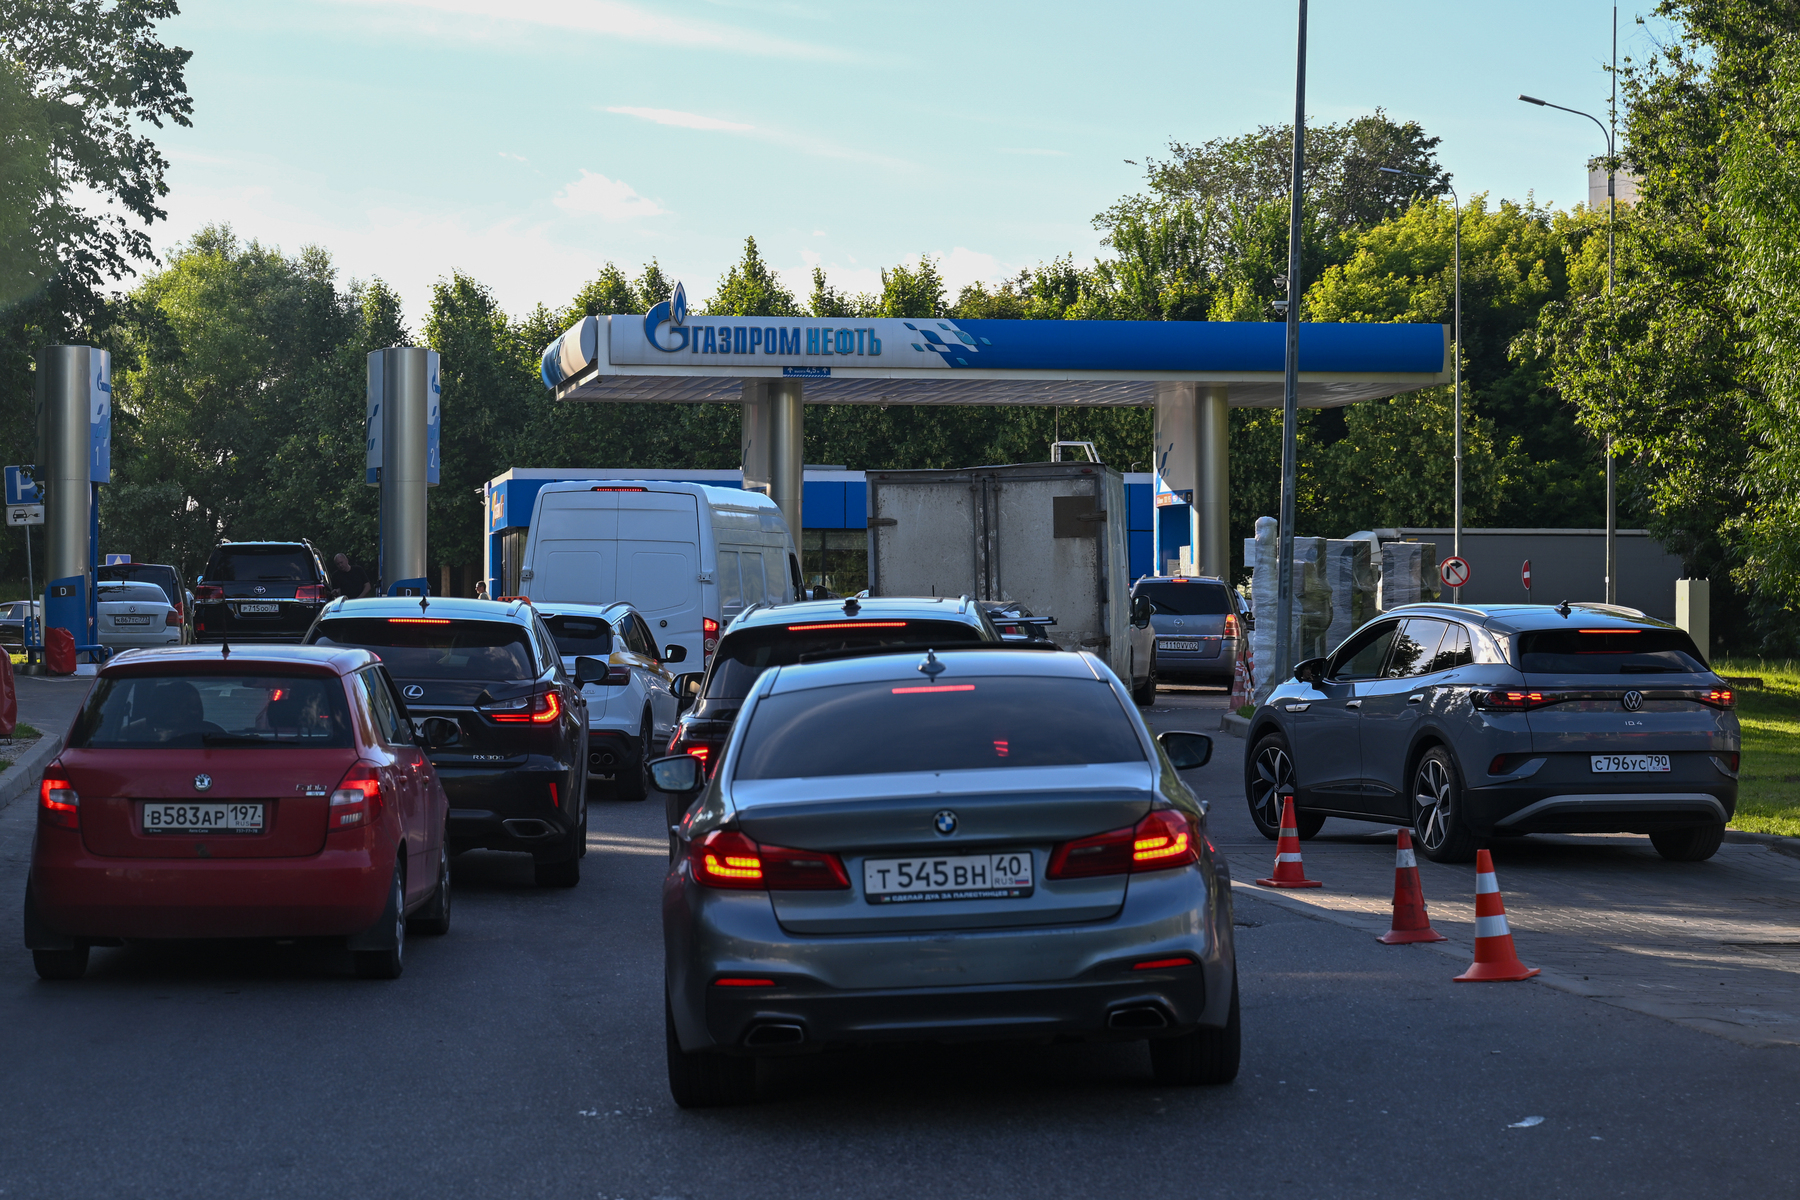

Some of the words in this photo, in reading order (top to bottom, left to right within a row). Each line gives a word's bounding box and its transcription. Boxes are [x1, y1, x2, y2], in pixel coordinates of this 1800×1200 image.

[691, 325, 801, 355] ГАЗПРОМ
[806, 326, 882, 356] НЕФТЬ
[95, 445, 99, 466] 1
[430, 447, 435, 468] 2
[59, 587, 67, 596] D
[1647, 756, 1668, 766] 790
[230, 805, 258, 821] 197
[994, 856, 1022, 876] 40
[994, 877, 1014, 886] RUS
[891, 893, 923, 903] СДЕЛАЙ
[941, 892, 953, 900] ЗА
[953, 889, 1009, 899] ПАЛЕСТИНЦЕВ
